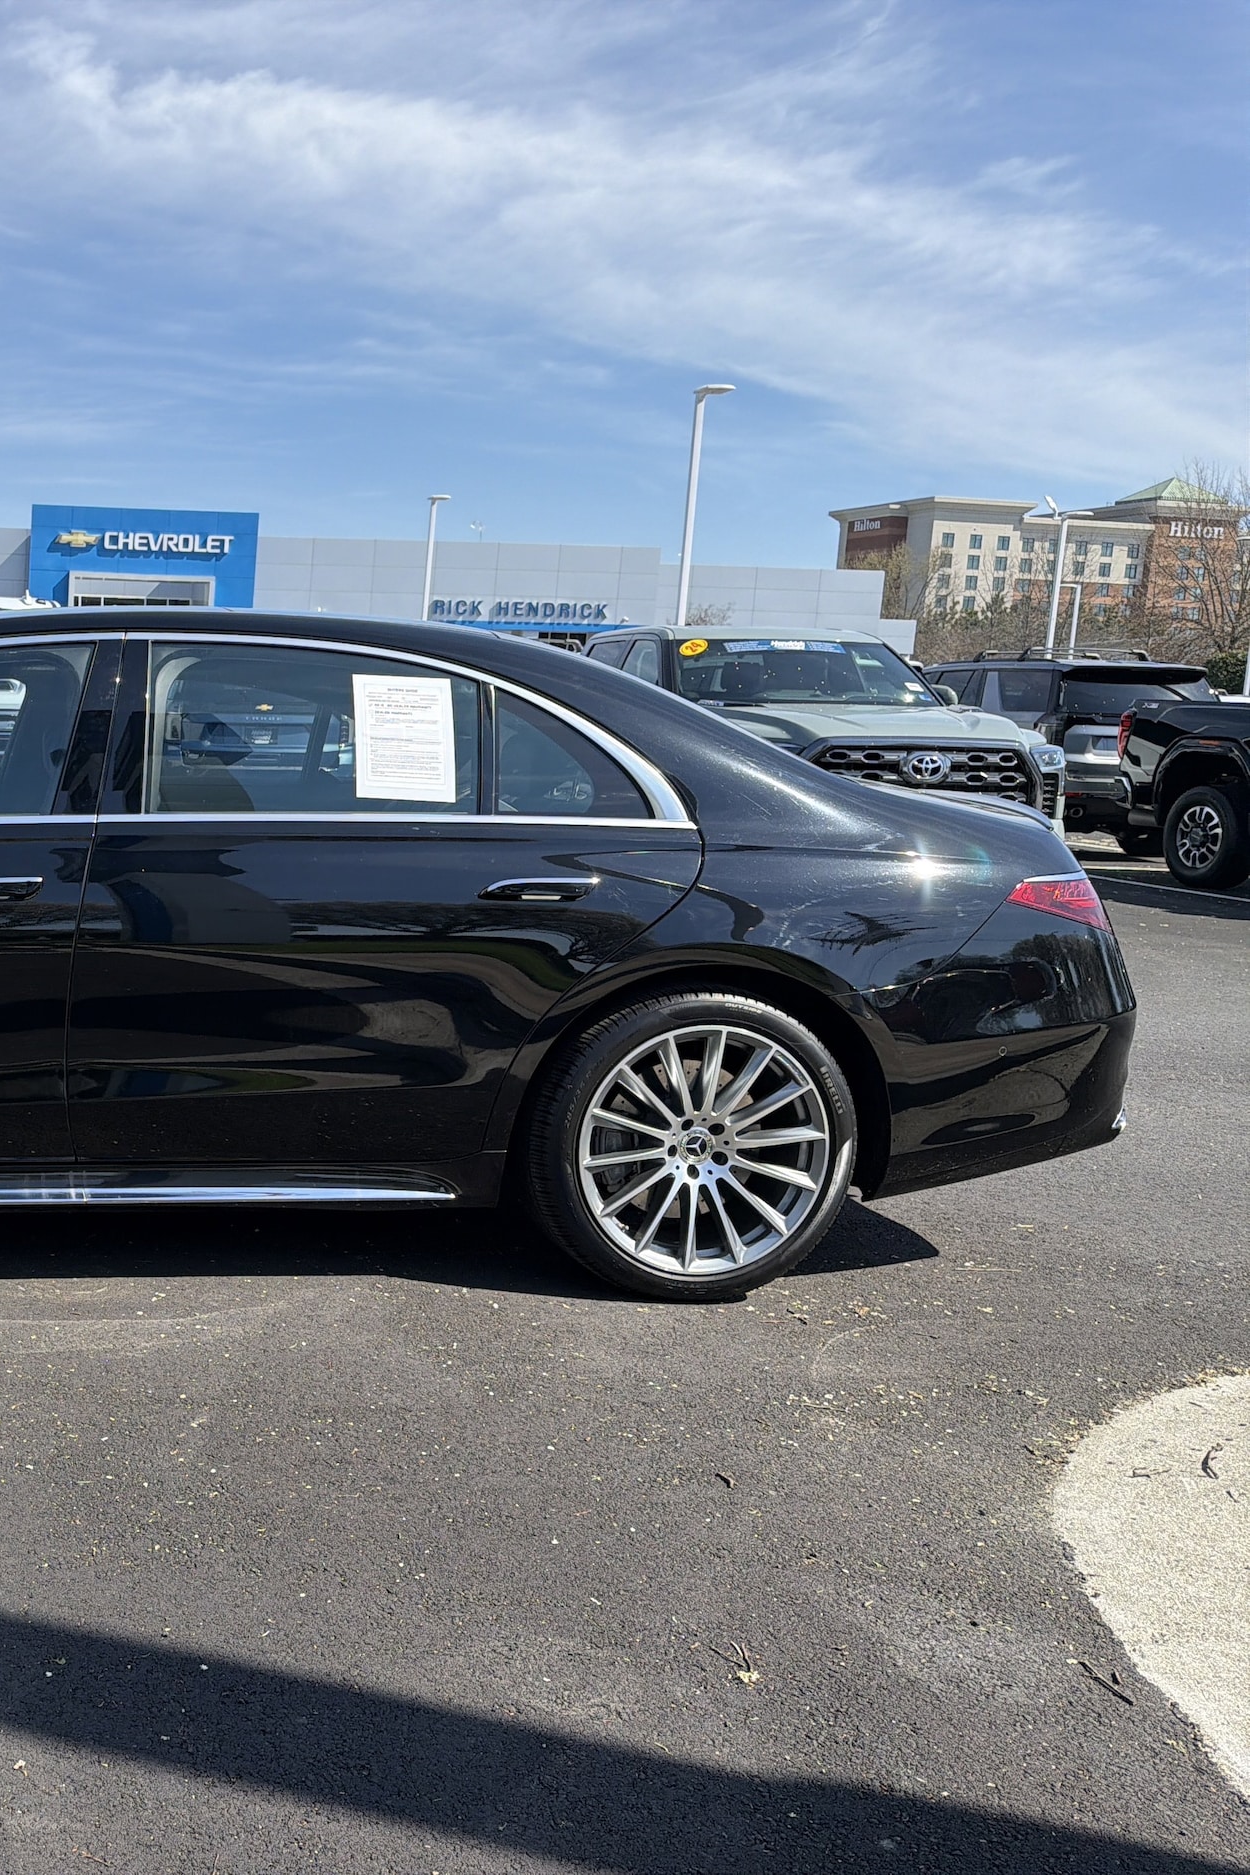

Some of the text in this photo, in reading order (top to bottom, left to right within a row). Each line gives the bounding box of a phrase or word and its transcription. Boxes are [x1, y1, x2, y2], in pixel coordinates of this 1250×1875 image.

[853, 517, 881, 532] Hilton
[1168, 520, 1225, 540] Hilton
[103, 531, 235, 554] CHEVROLET
[432, 599, 609, 620] RICK HENDRICK
[819, 1064, 846, 1115] PIRELLI
